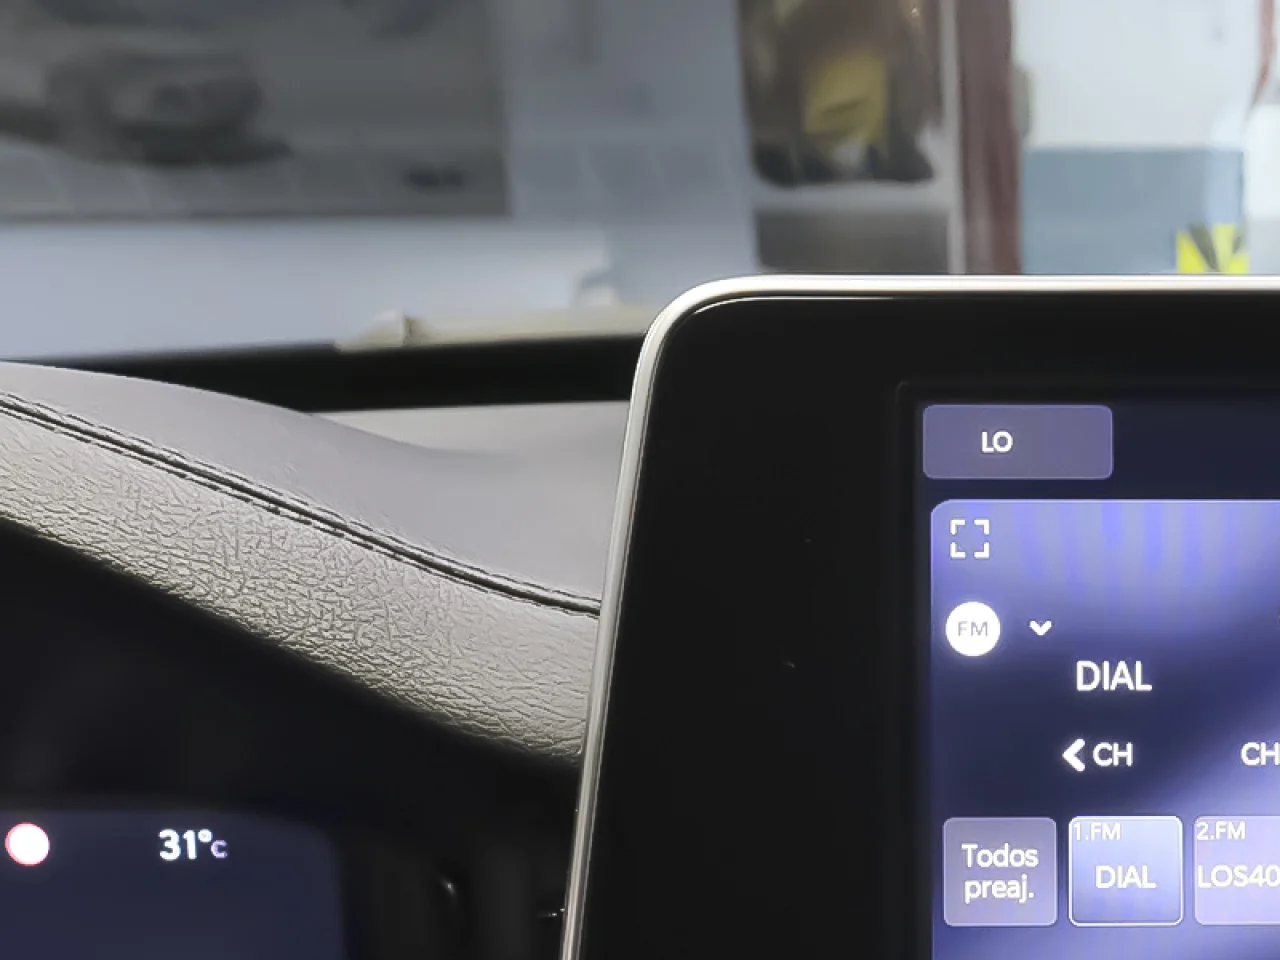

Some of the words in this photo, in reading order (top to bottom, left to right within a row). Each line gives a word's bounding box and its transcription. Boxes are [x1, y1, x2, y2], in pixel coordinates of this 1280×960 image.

[981, 431, 1014, 454] LO
[957, 621, 989, 637] FM
[1076, 661, 1153, 691] DIAL
[1092, 742, 1133, 767] CH
[1241, 742, 1280, 766] CH
[1072, 822, 1121, 841] 1.FM
[1196, 821, 1246, 840] 2.FM
[961, 843, 1039, 868] Todos
[1095, 865, 1157, 889] DIAL
[964, 875, 1035, 904] preaj.
